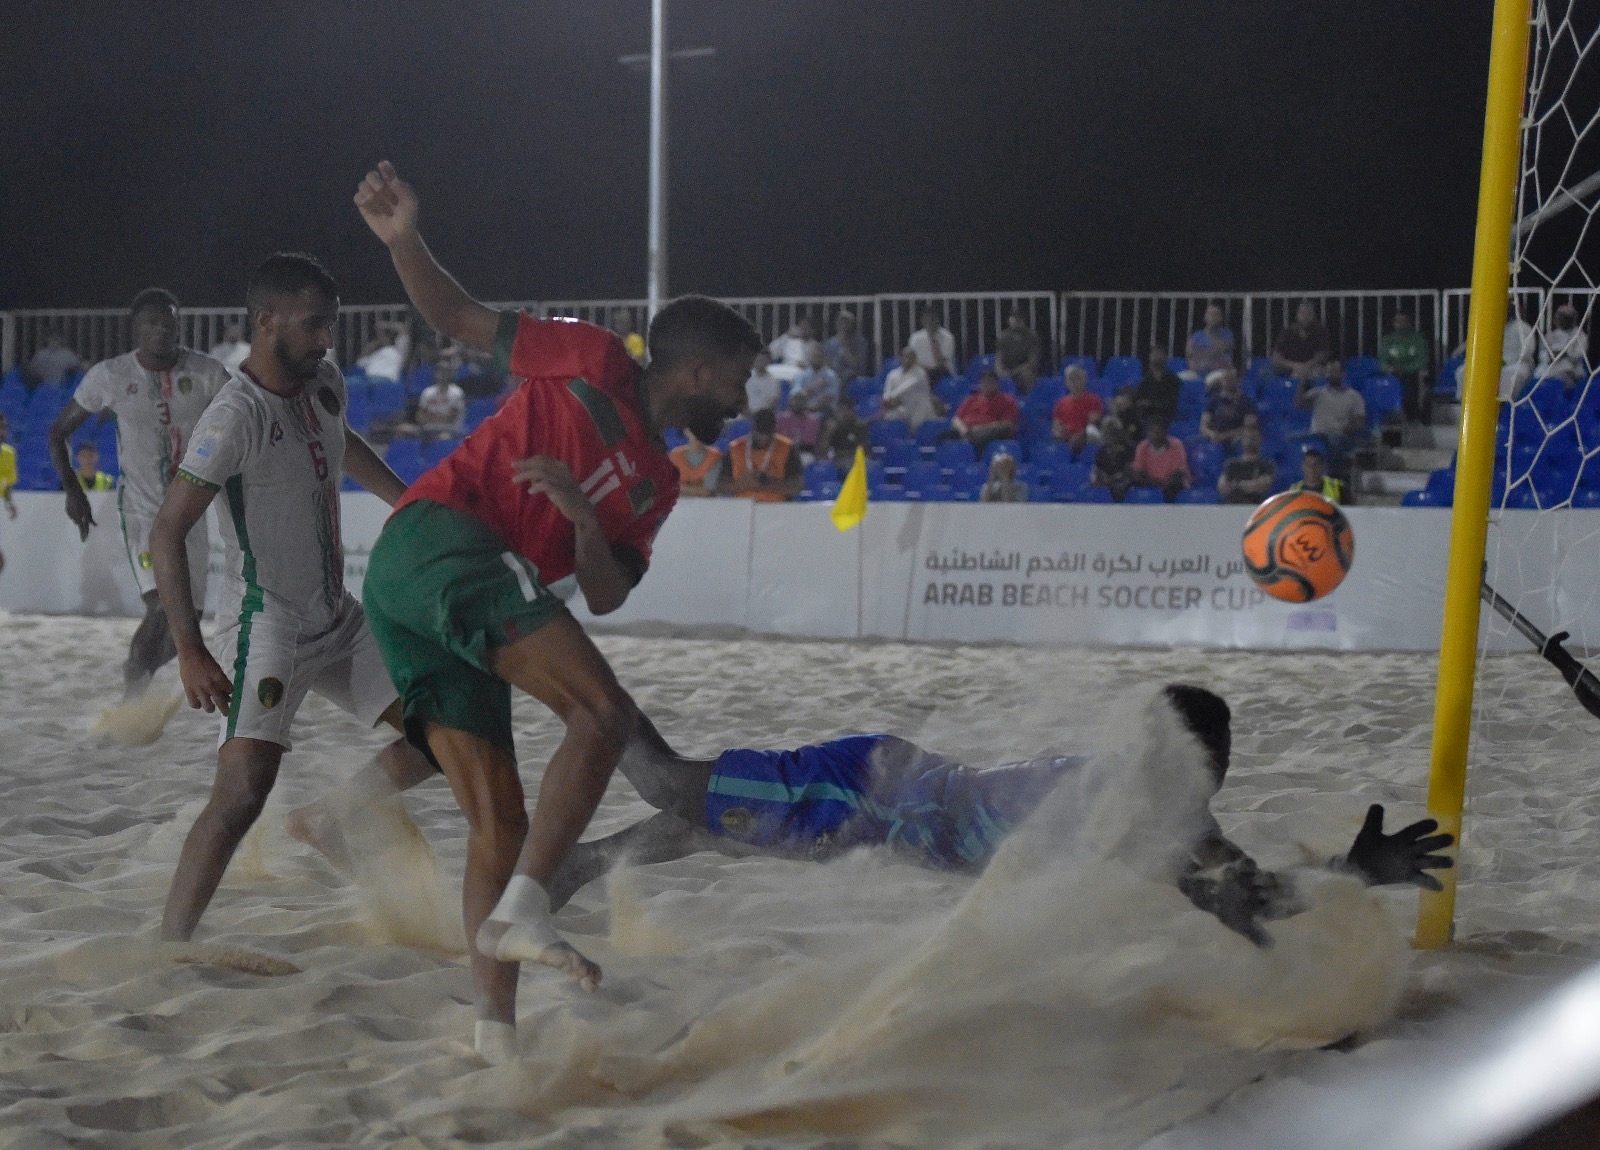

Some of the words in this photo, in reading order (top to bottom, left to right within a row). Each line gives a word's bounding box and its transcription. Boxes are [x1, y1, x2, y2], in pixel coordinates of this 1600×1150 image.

[156, 402, 171, 425] 3
[307, 440, 329, 482] 6
[580, 458, 621, 505] 11
[1026, 552, 1087, 578] القدم
[1092, 553, 1142, 578] لكرة
[1148, 553, 1210, 578] العرب
[924, 582, 993, 606] ARAB
[1002, 583, 1089, 607] BEACH
[1098, 584, 1202, 610] SOCCER
[1211, 586, 1266, 611] CUP
